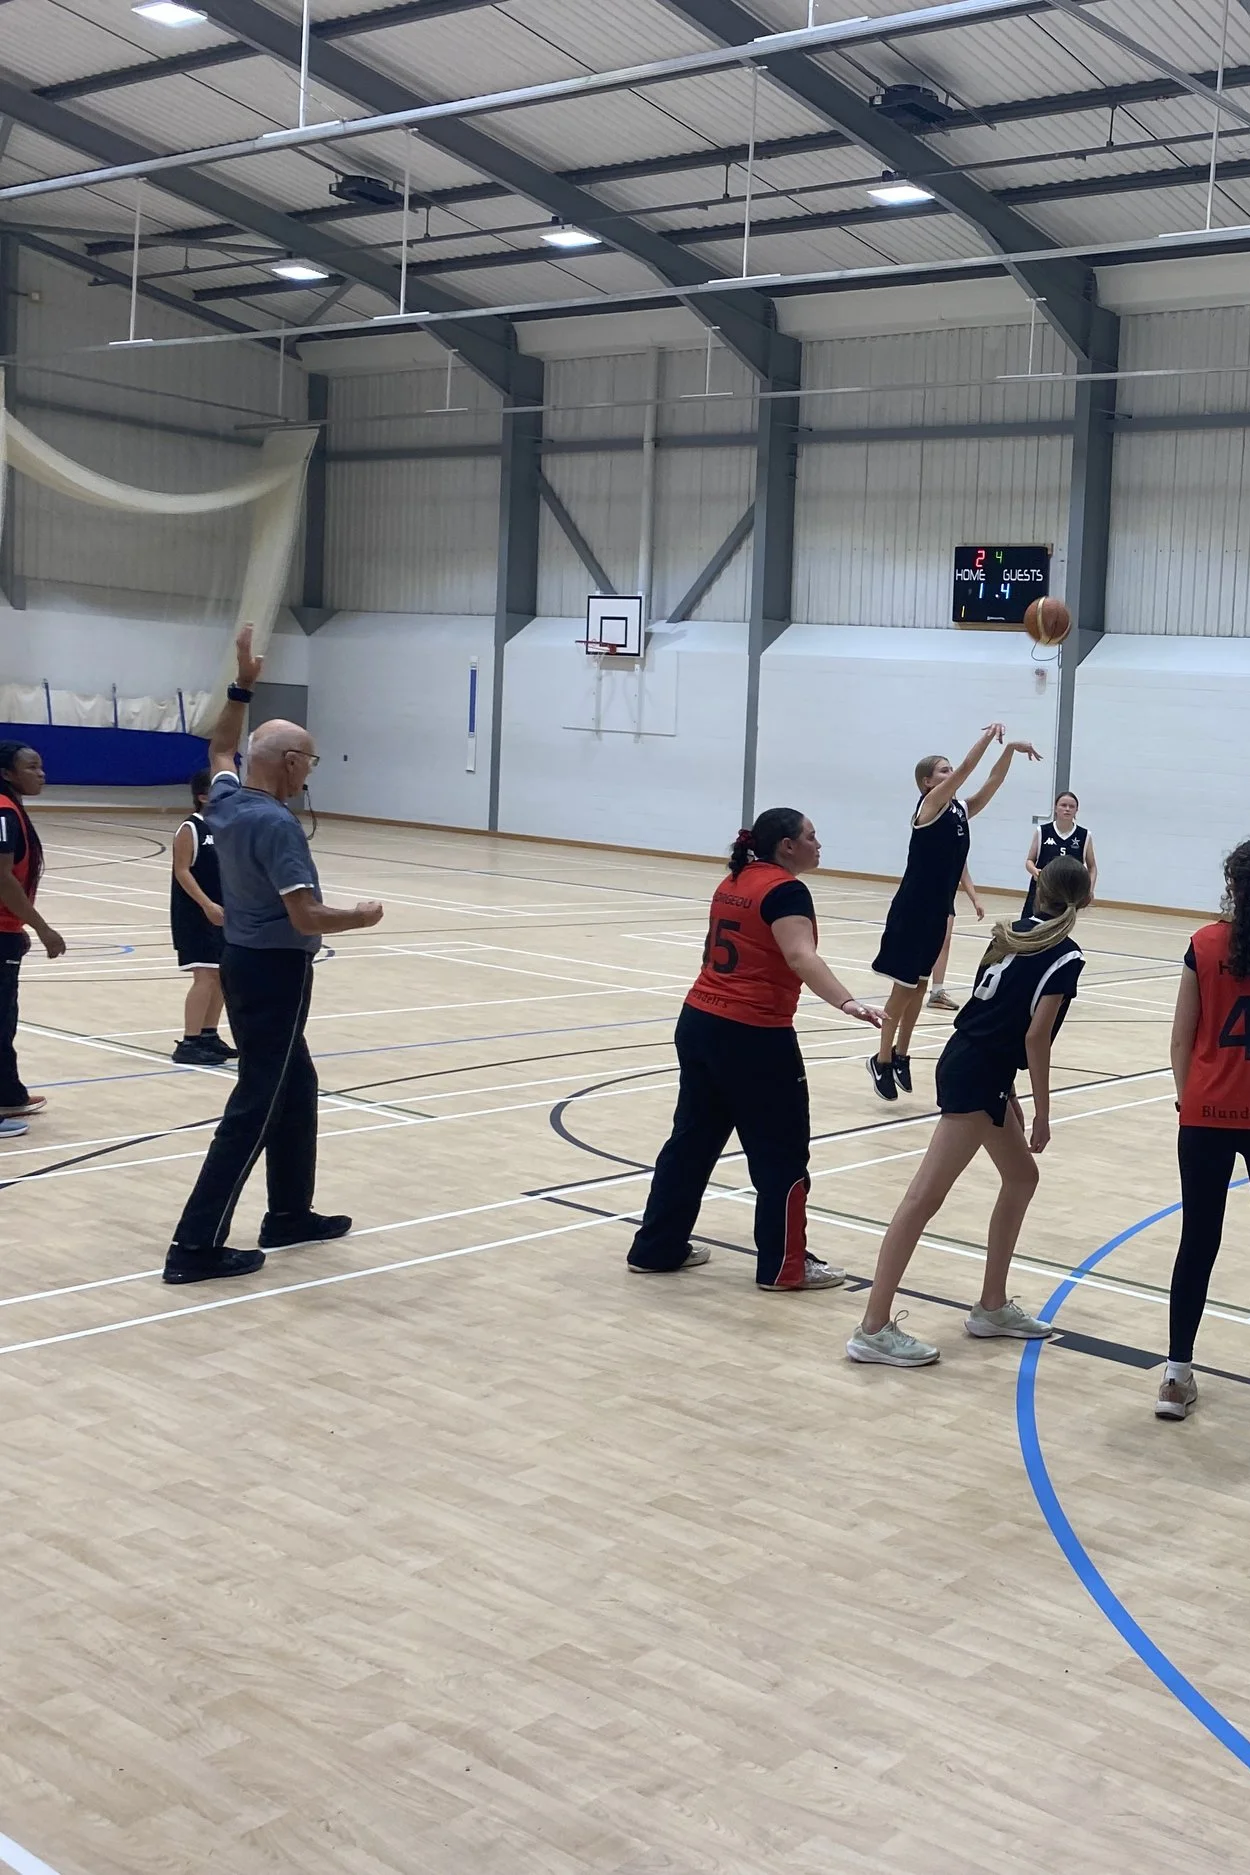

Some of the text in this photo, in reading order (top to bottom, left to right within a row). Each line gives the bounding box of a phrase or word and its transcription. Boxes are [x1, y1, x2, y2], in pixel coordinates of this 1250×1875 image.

[975, 550, 985, 568] 2
[955, 569, 1044, 582] HOME GUESTS
